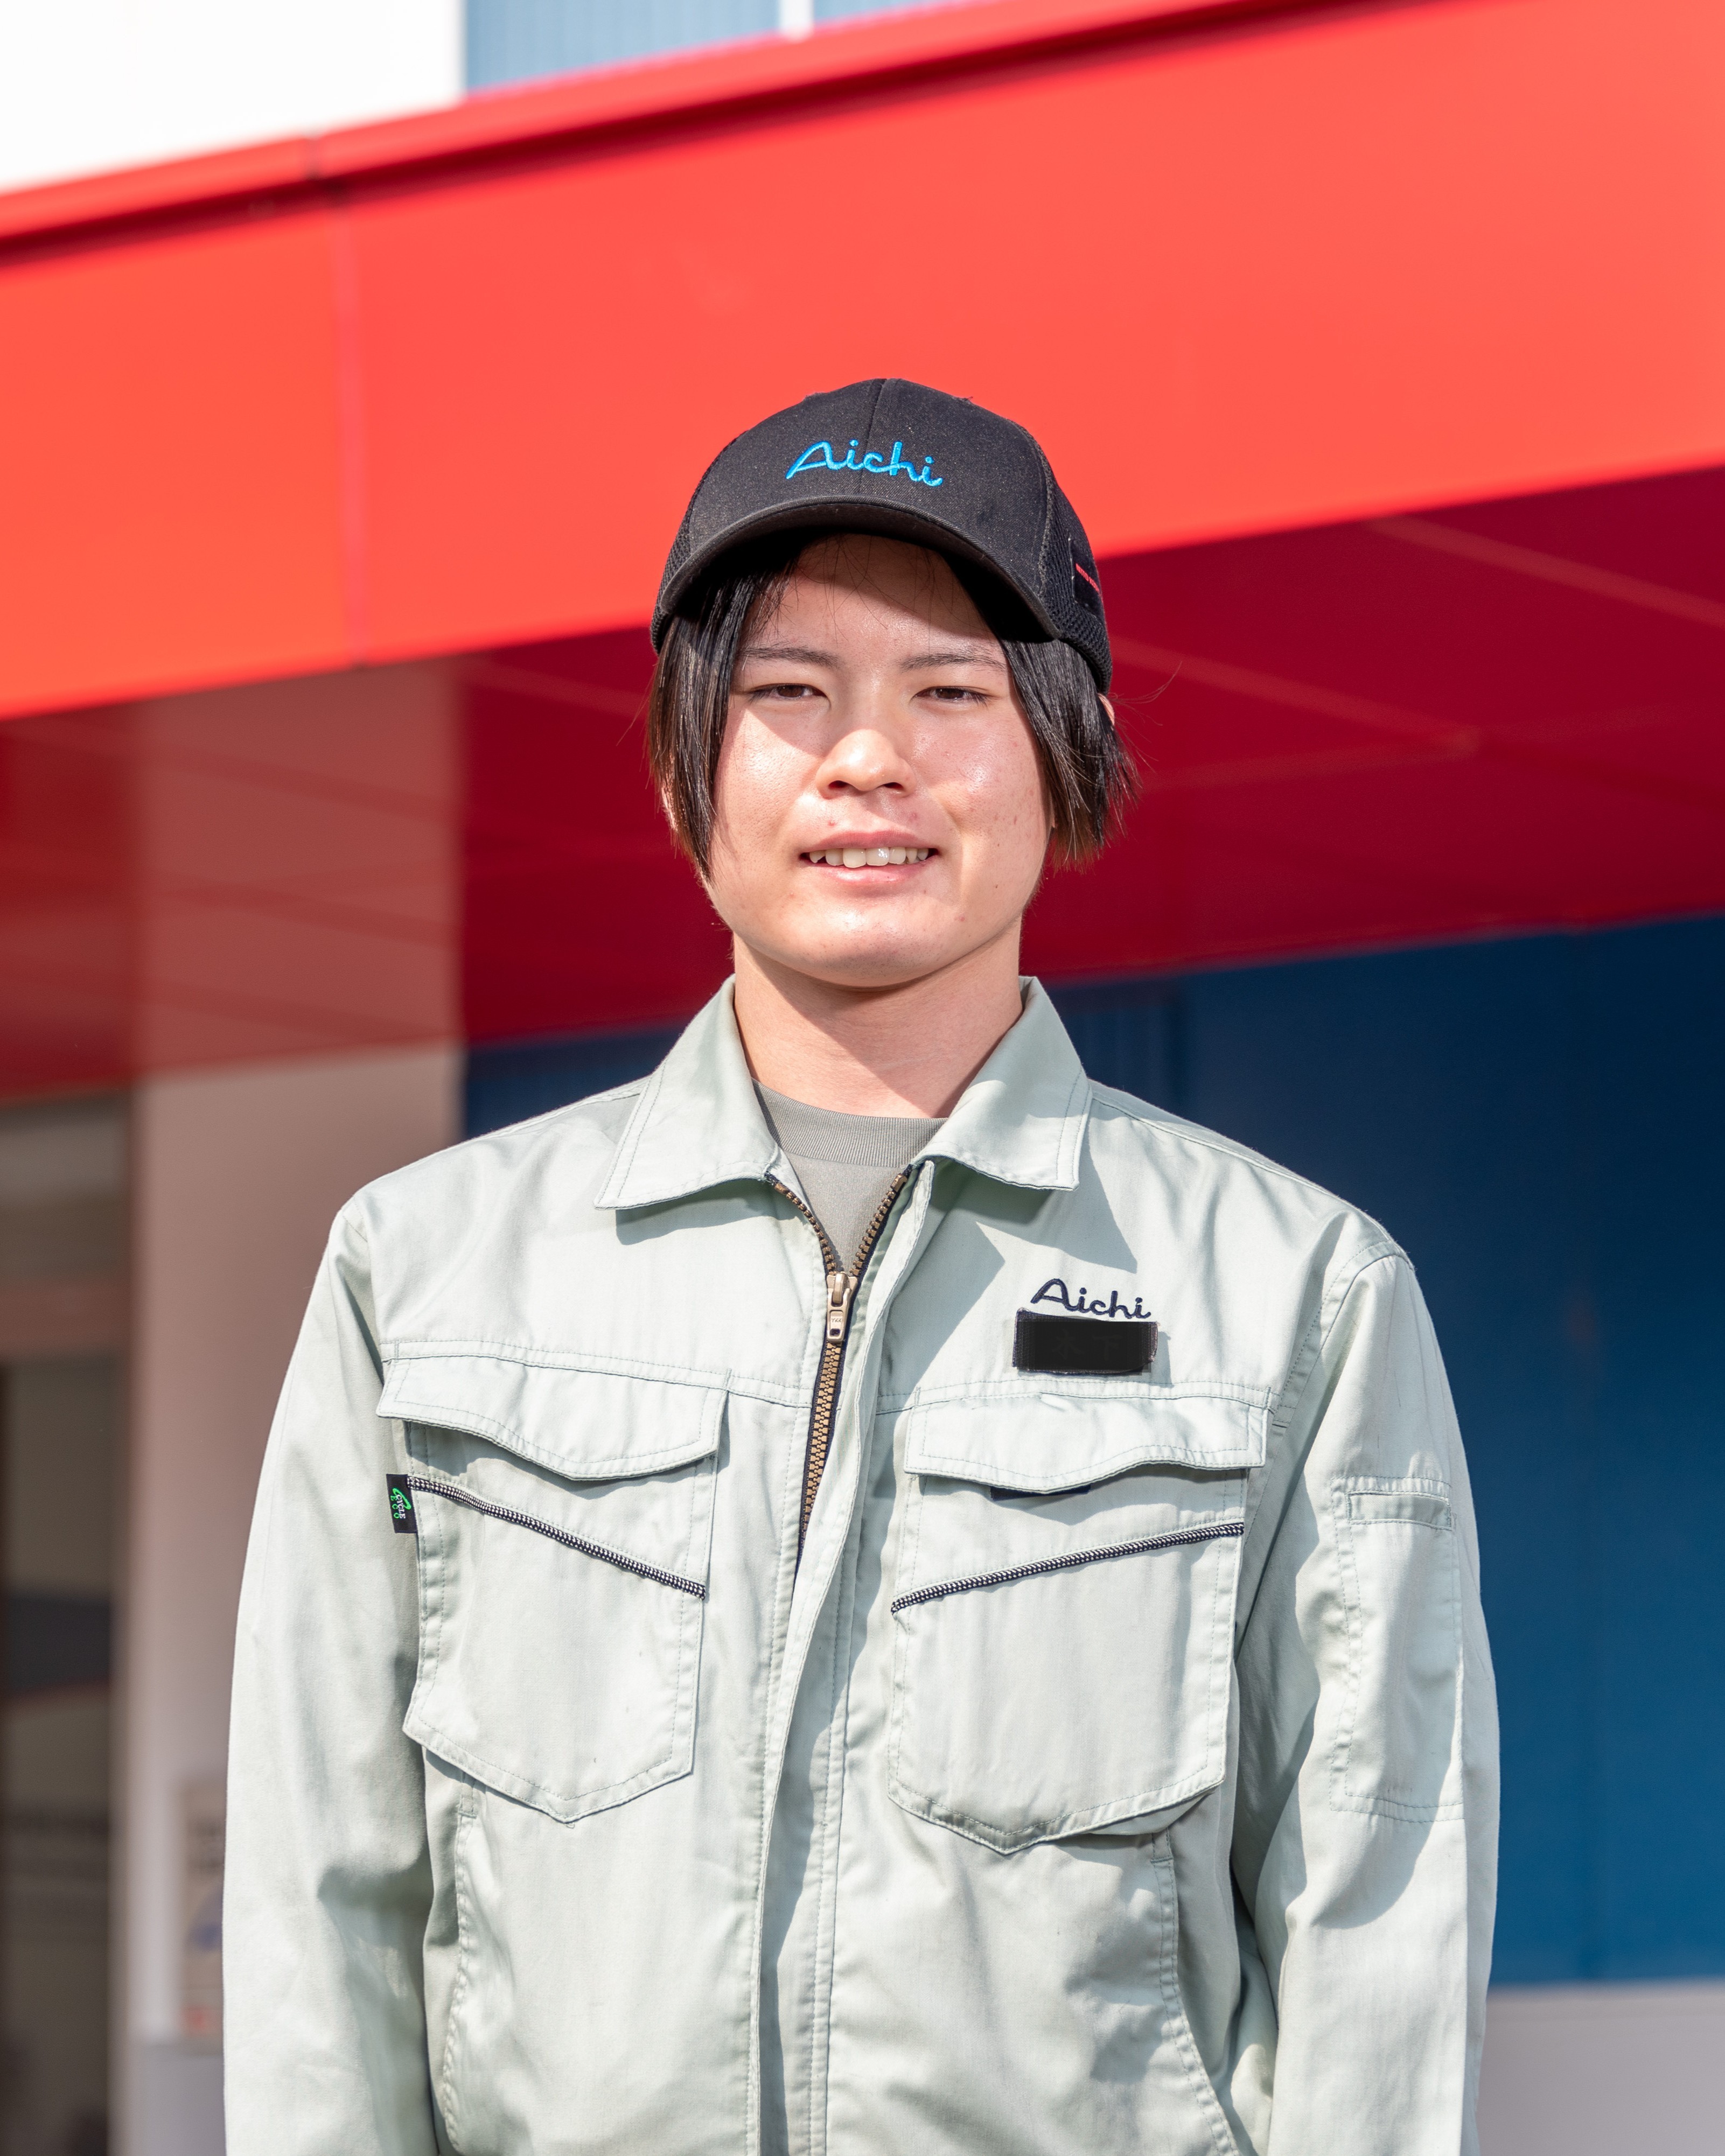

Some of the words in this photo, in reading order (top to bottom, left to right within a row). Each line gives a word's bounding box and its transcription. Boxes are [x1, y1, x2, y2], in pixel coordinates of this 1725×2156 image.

[786, 439, 943, 486] Aichi
[1030, 1278, 1151, 1319] Aichi
[390, 1495, 400, 1518] ECO
[396, 1494, 406, 1519] CYCLE
